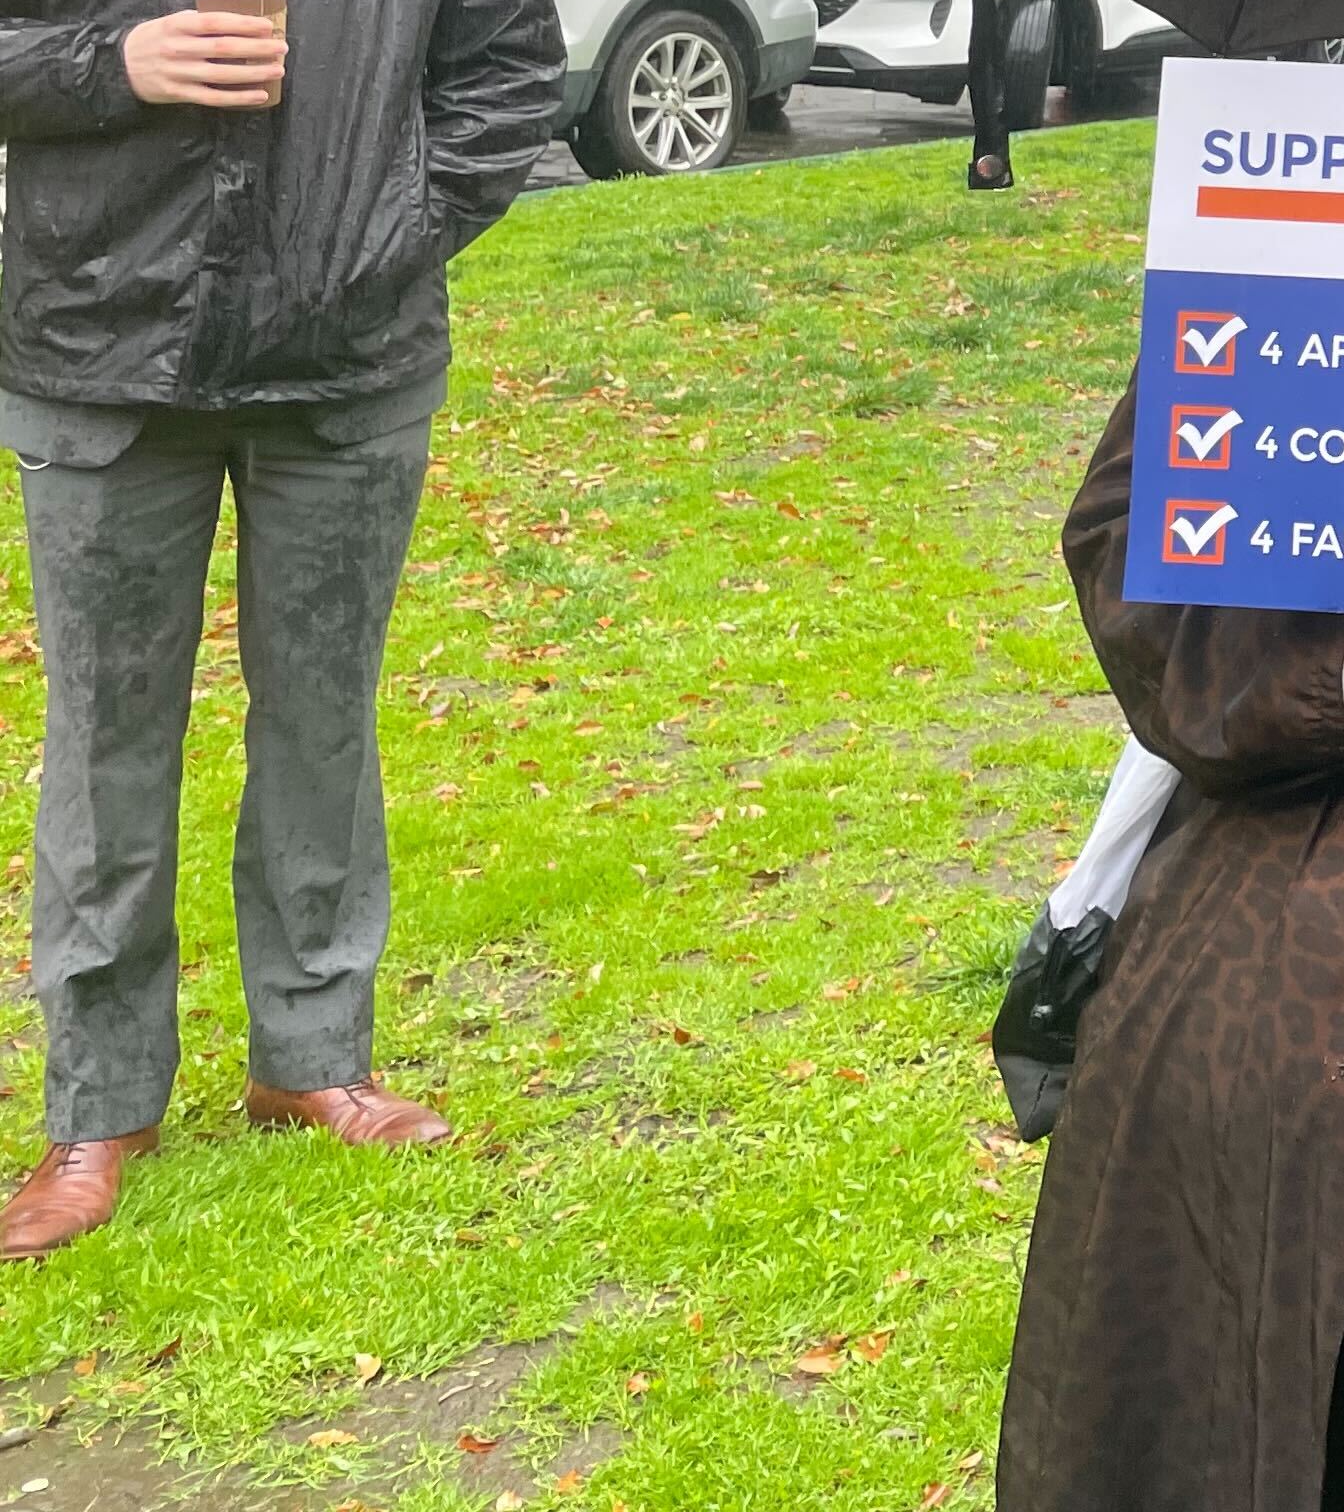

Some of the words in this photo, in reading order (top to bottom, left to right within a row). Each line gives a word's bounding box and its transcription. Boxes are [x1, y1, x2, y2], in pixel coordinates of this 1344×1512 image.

[1259, 331, 1283, 365] 4
[1255, 425, 1278, 460] 4
[1250, 520, 1274, 555] 4
